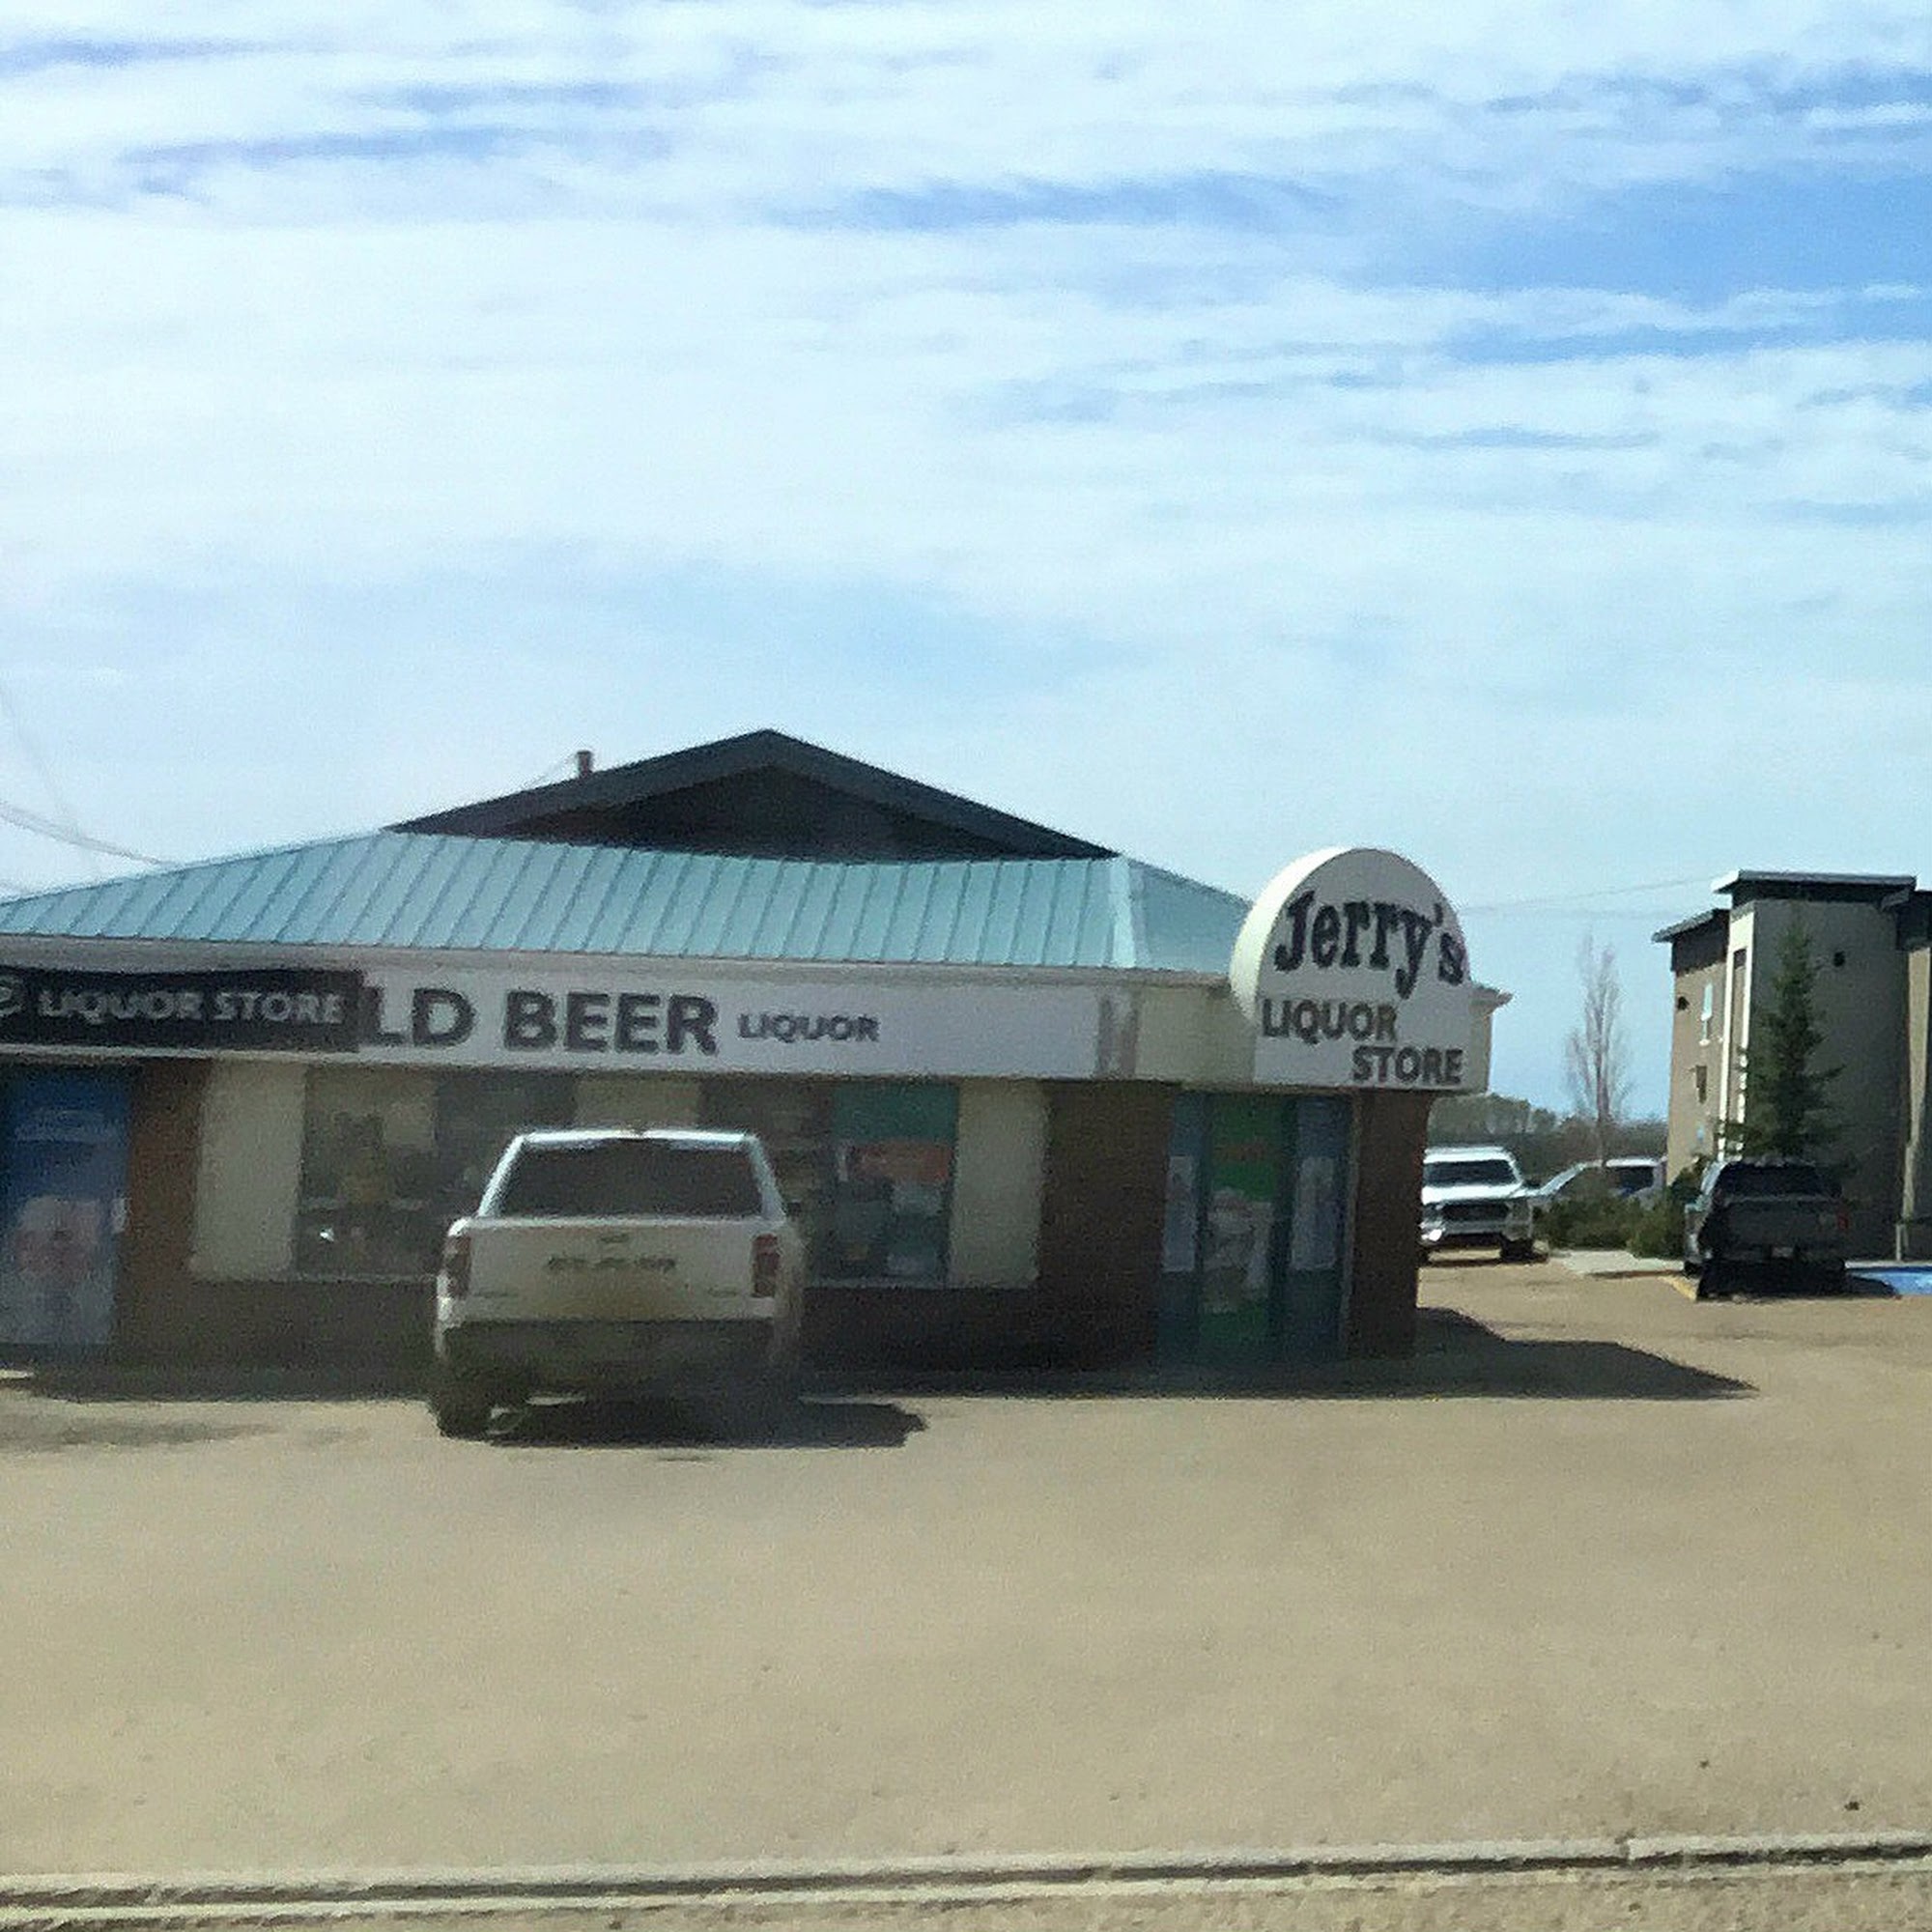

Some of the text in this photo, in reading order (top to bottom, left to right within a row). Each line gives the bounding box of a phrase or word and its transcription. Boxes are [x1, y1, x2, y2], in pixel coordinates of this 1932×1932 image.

[1274, 890, 1465, 1000] Jerry's
[39, 990, 203, 1025] LIQUOR
[213, 991, 343, 1024] STORE
[503, 991, 718, 1056] BEER
[738, 1012, 880, 1043] LIQUOR
[1262, 998, 1398, 1045] LIQUOR
[1352, 1045, 1463, 1085] STORE
